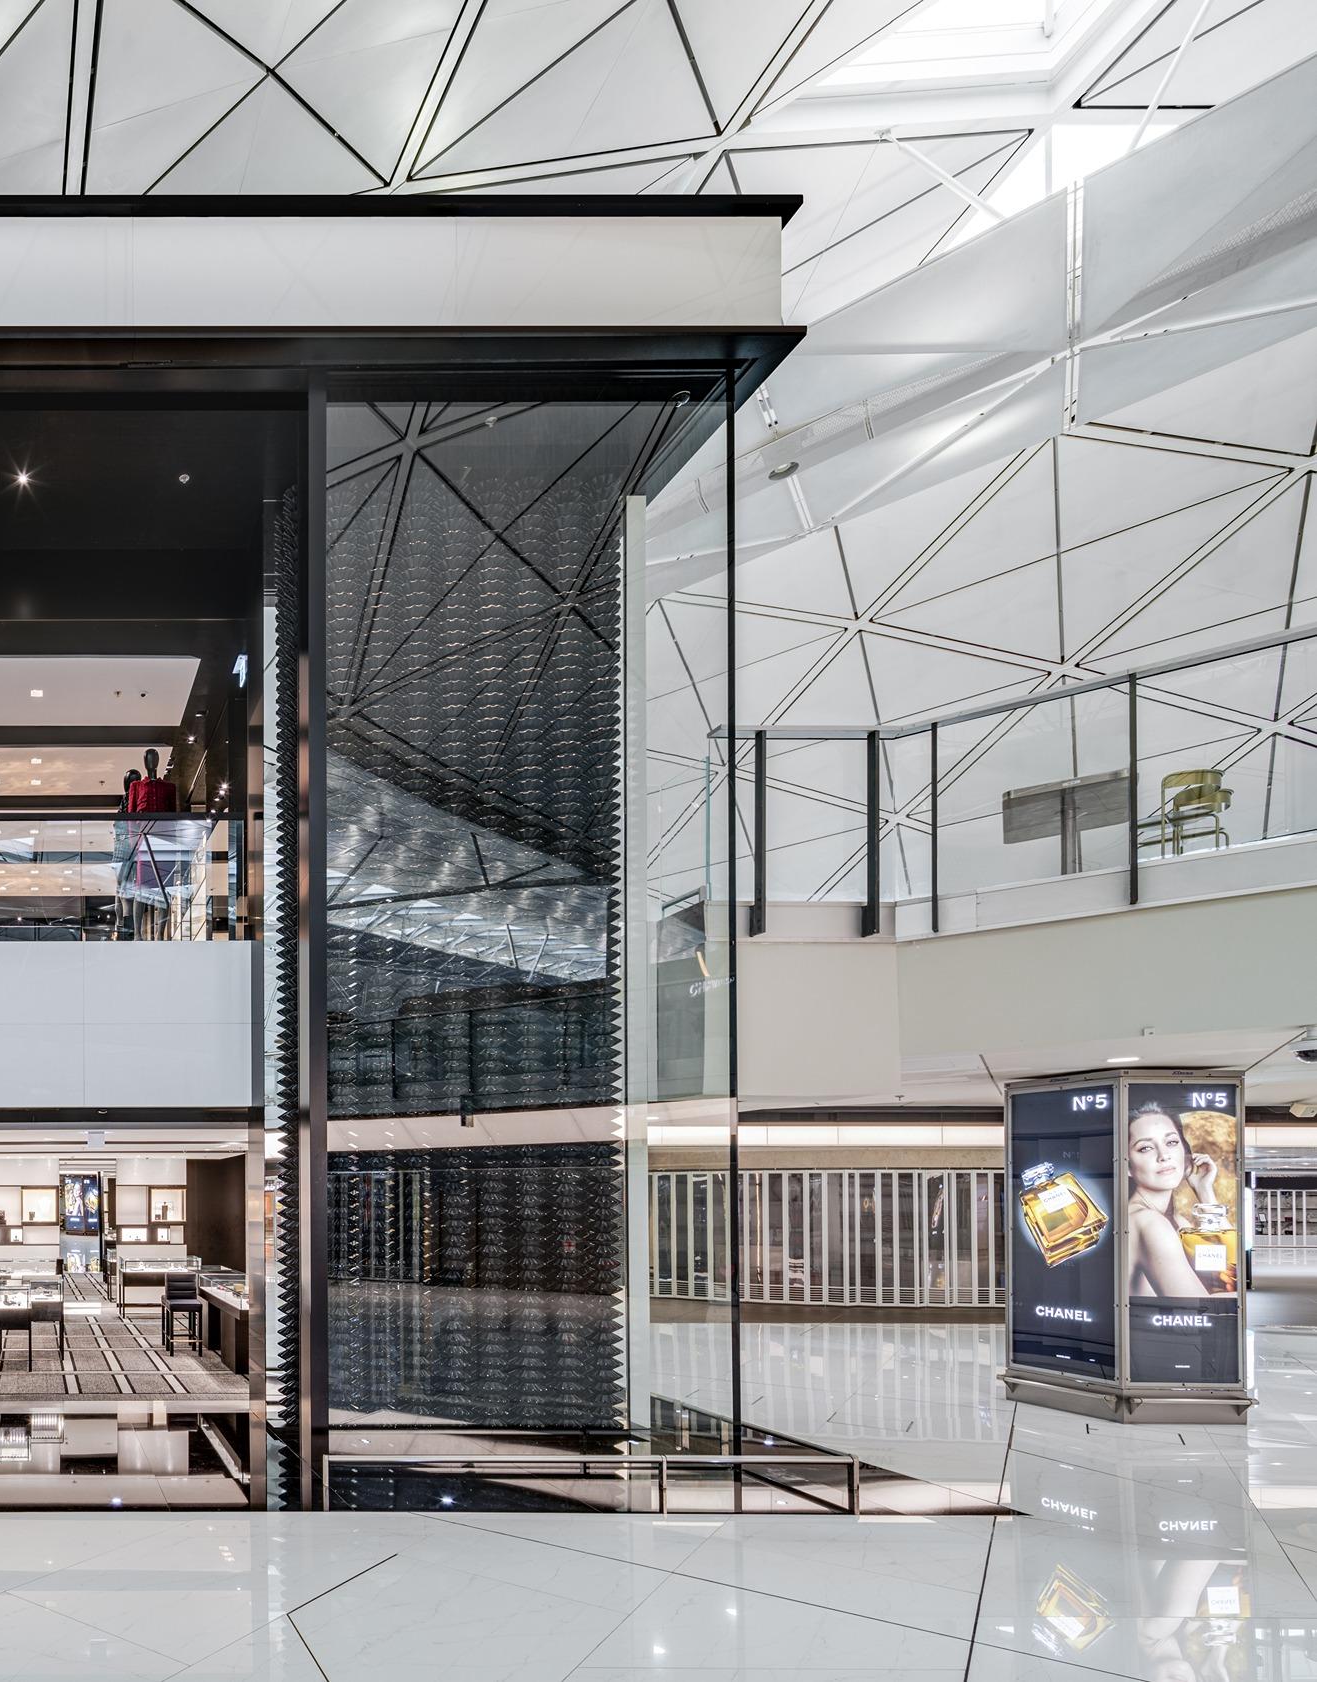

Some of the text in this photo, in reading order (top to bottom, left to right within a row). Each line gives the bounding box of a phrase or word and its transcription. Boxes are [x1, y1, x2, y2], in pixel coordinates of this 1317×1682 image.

[1073, 1094, 1108, 1111] N°5
[1192, 1092, 1228, 1108] N°5
[1035, 1305, 1092, 1322] CHANEL
[1152, 1315, 1212, 1327] CHANEL
